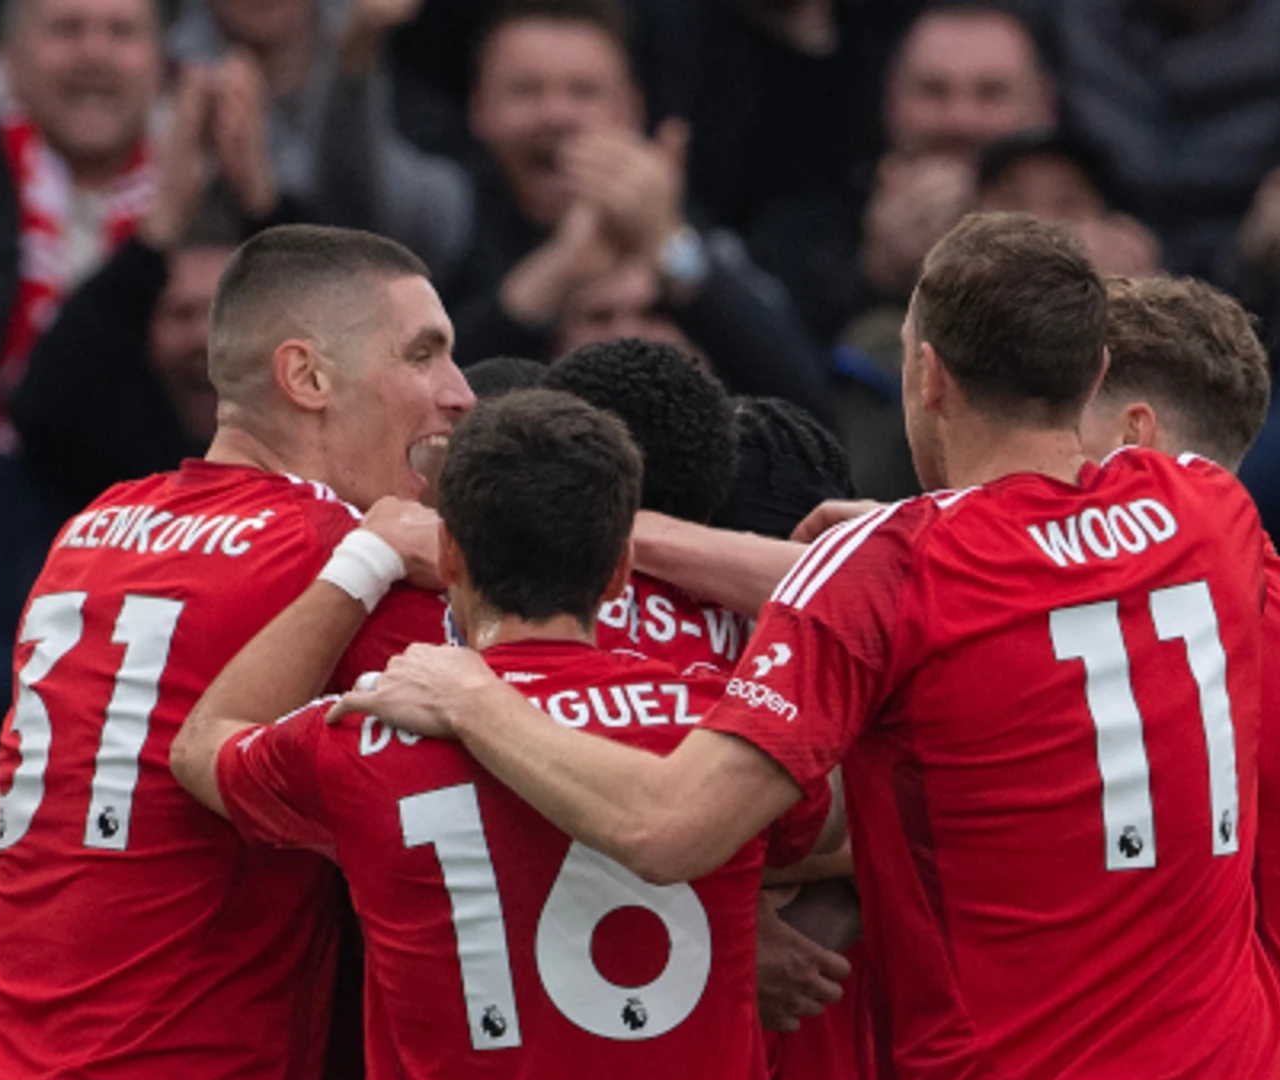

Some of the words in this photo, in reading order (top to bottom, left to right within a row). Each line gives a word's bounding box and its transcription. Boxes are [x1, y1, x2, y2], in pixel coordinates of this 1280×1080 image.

[1027, 498, 1178, 567] WOOD
[1048, 578, 1239, 871] 11
[398, 782, 712, 1050] 16
